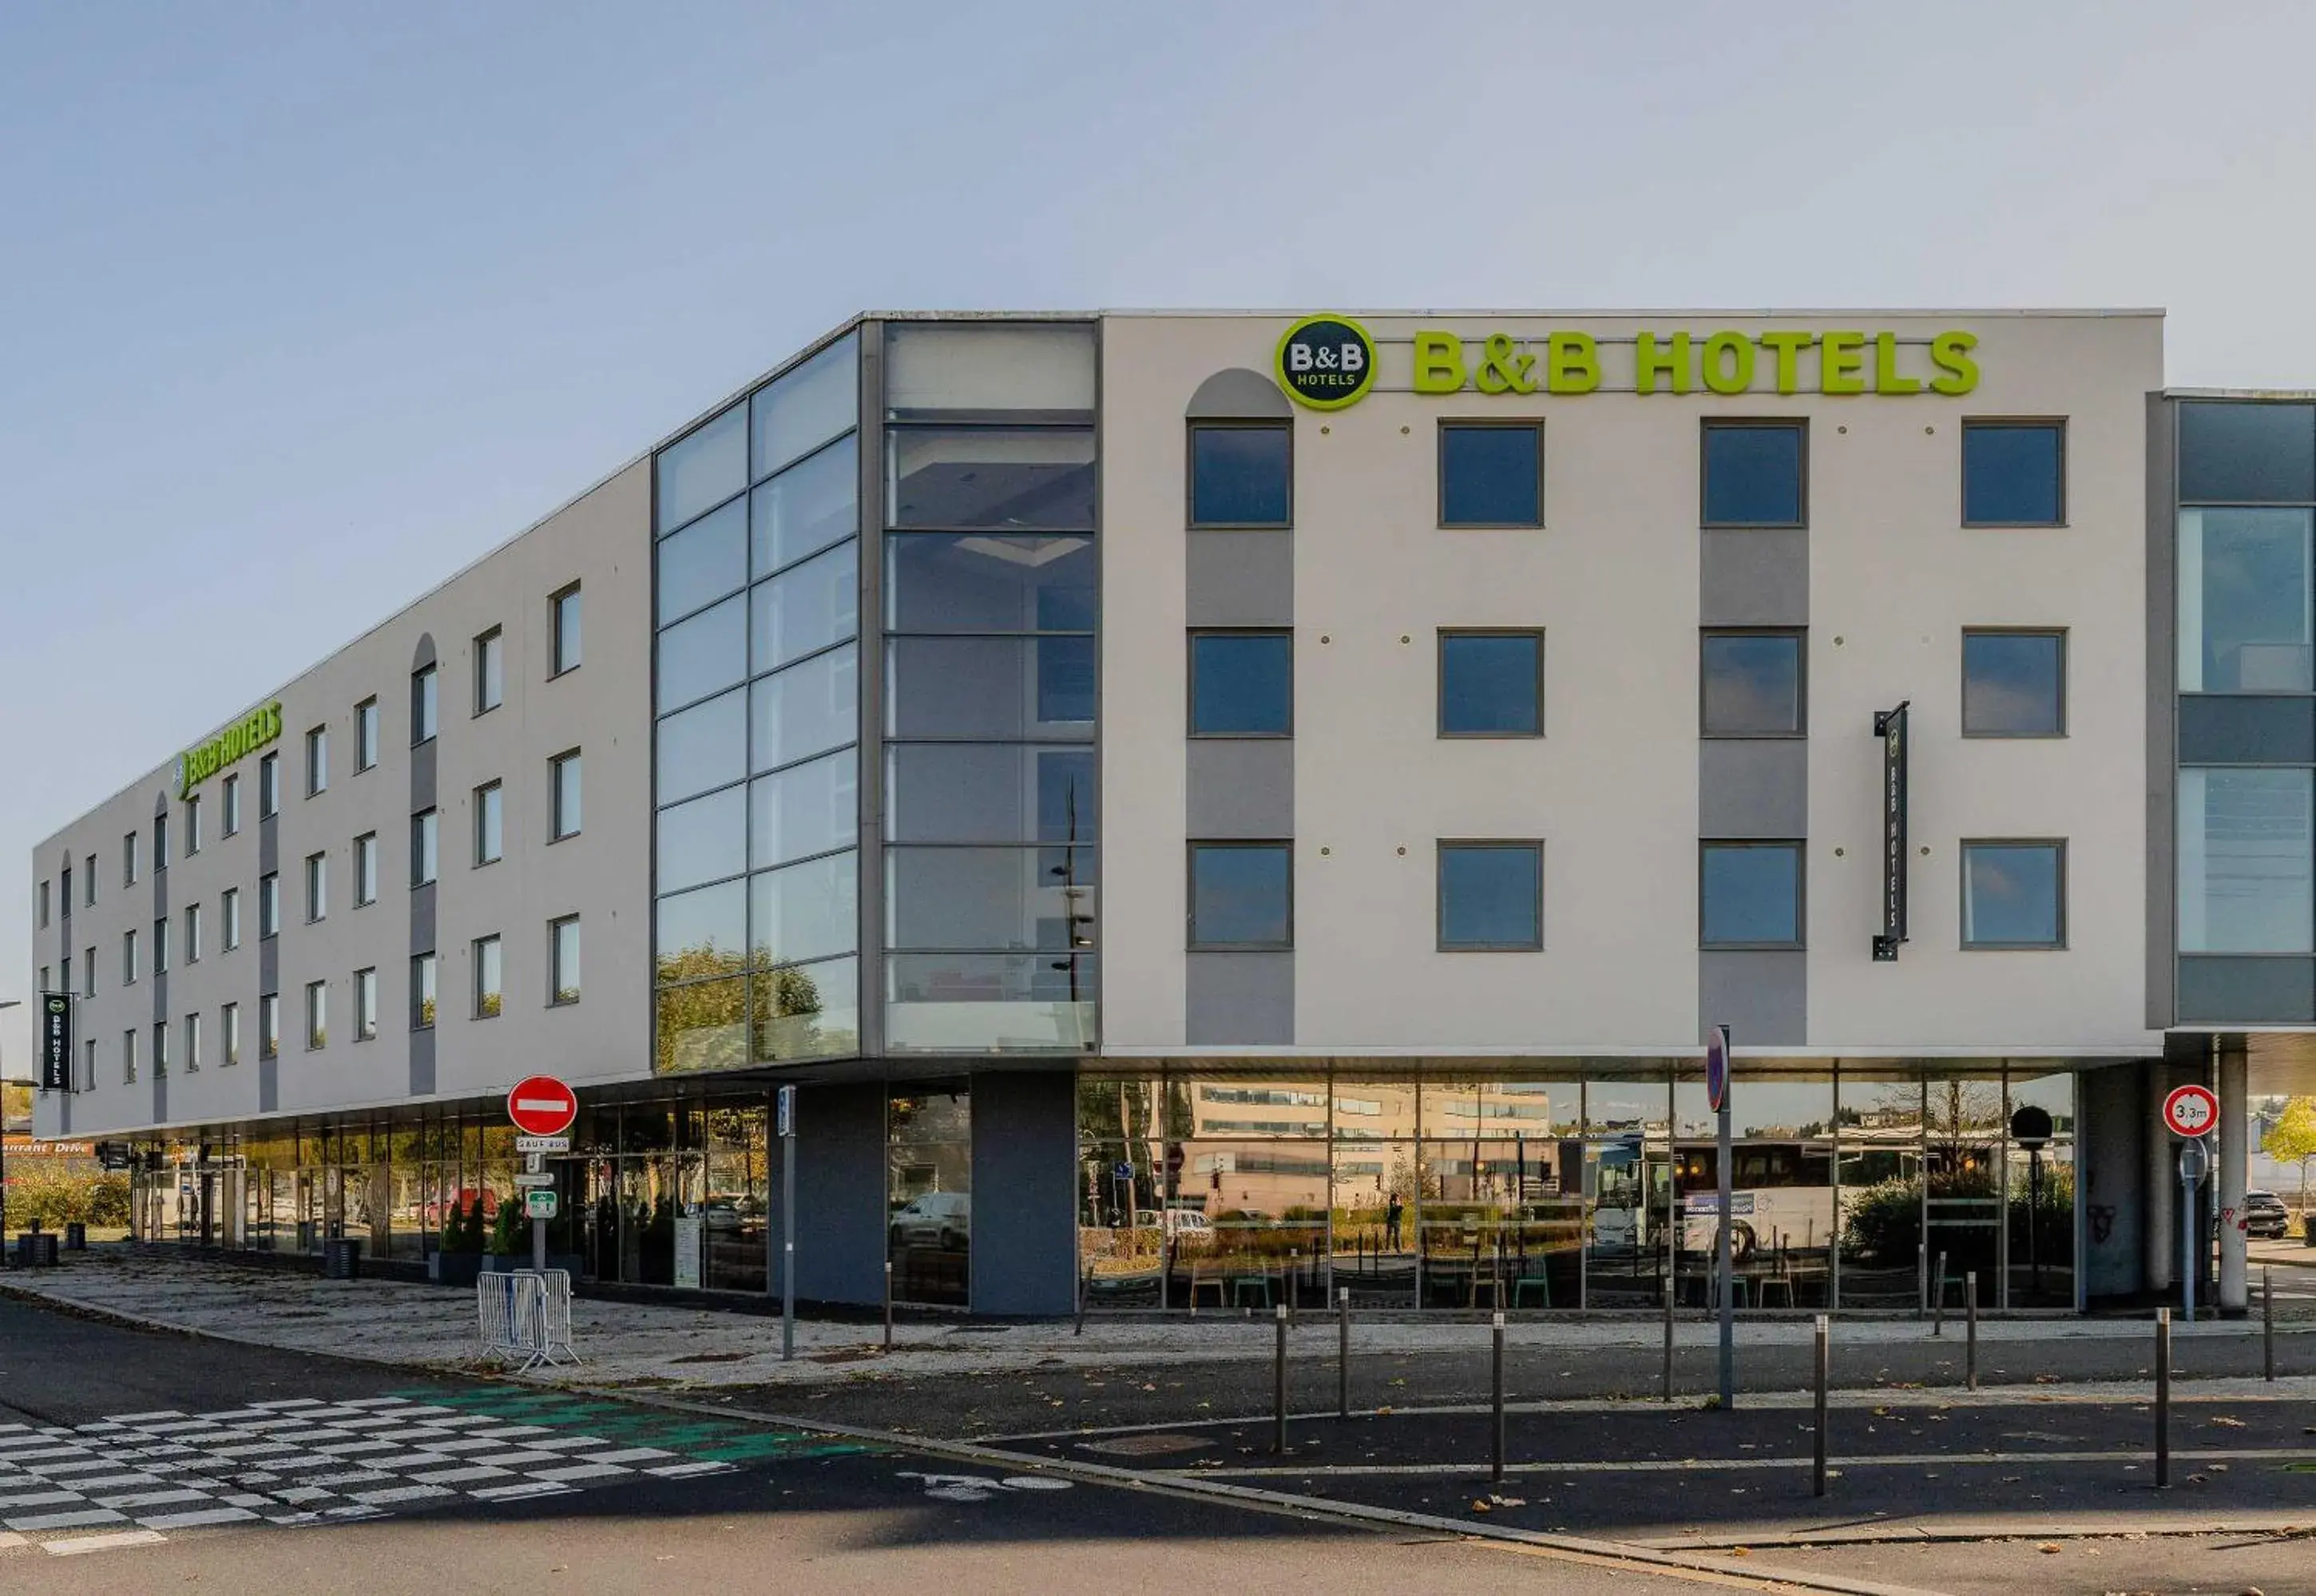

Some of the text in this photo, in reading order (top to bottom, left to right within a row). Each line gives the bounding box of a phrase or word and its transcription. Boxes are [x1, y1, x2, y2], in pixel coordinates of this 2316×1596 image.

[1291, 343, 1364, 371] B&B
[1297, 374, 1356, 386] HOTELS
[1415, 331, 1980, 396] B&B HOTELS
[220, 701, 282, 768] HOTELS
